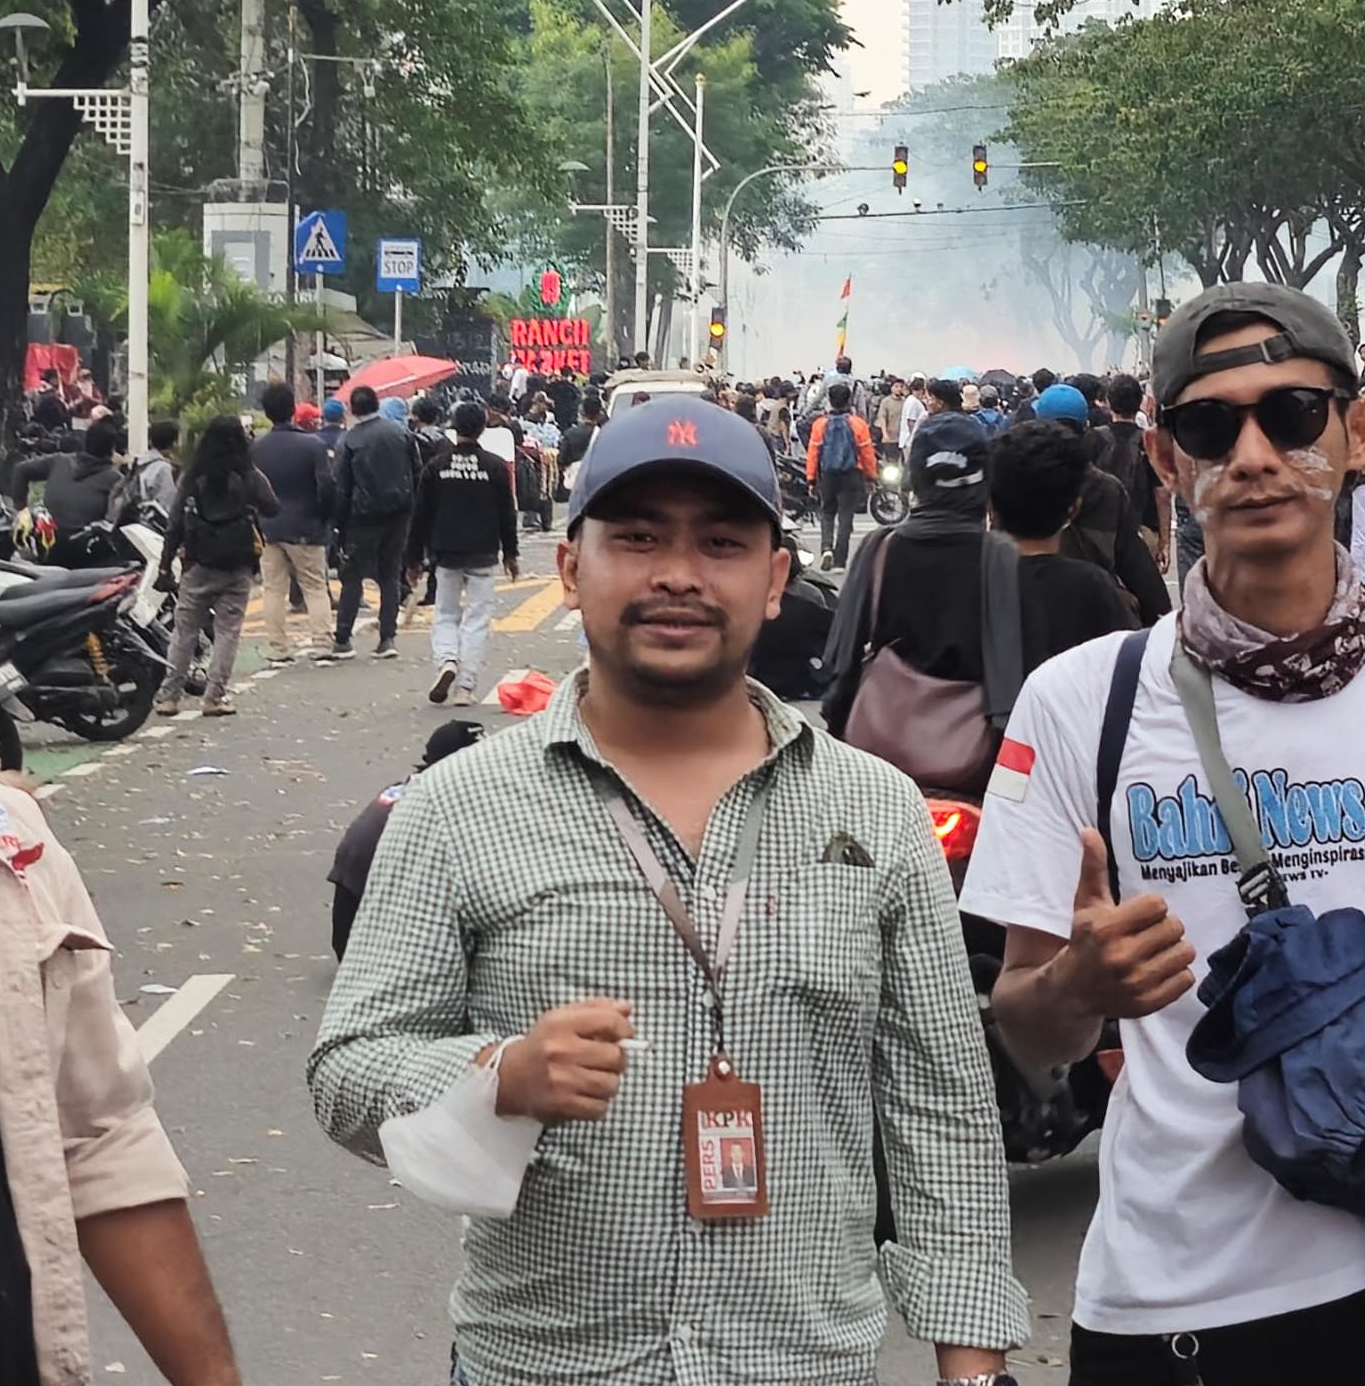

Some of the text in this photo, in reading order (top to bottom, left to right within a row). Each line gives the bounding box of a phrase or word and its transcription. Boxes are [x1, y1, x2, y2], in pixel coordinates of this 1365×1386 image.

[384, 259, 413, 275] STOP
[1140, 861, 1218, 883] Menyajikan
[706, 1109, 753, 1128] KPK
[701, 1139, 717, 1190] PERS
